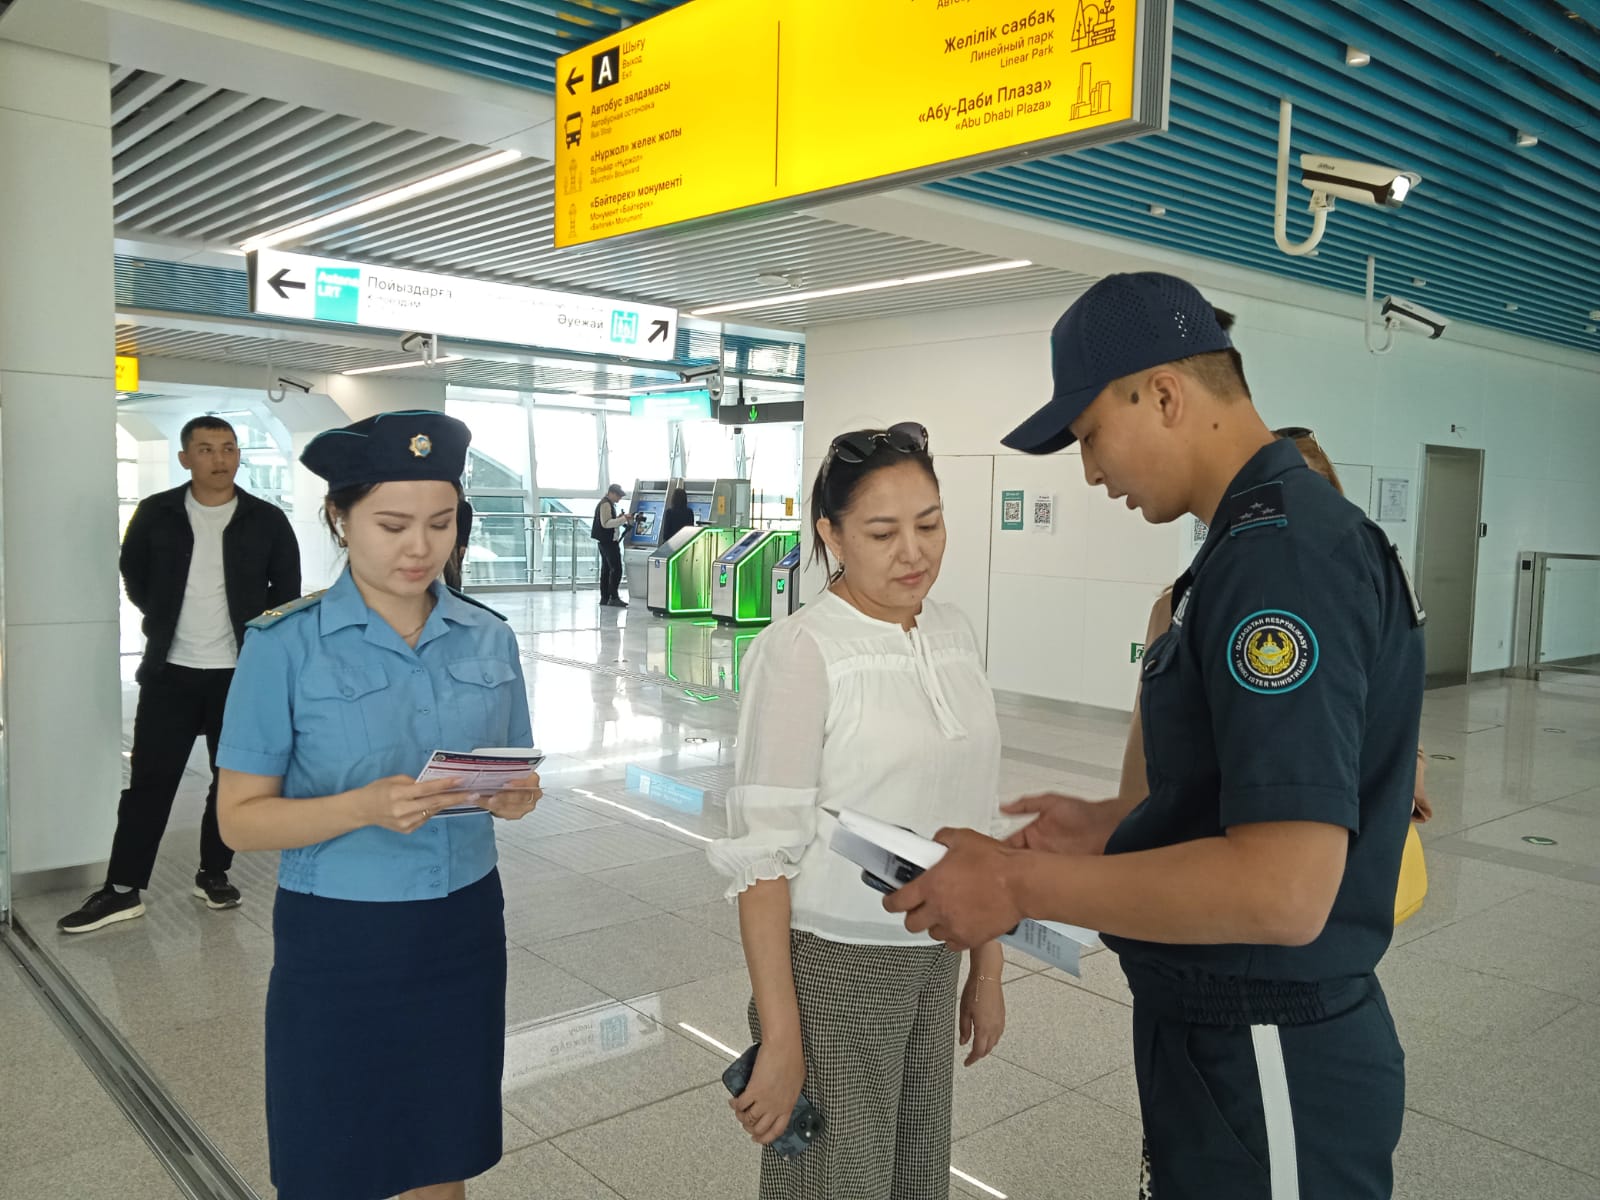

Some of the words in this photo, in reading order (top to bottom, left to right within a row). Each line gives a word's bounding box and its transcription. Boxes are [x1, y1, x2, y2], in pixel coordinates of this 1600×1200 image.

[944, 25, 997, 54] Желілік
[1001, 8, 1055, 36] саябақ
[622, 38, 646, 55] Шығу
[970, 36, 1024, 63] Линейный
[1027, 30, 1054, 47] парк
[1000, 53, 1029, 68] Linear
[1031, 45, 1054, 60] Park
[622, 55, 642, 69] Выход
[591, 98, 623, 116] Автобус
[624, 81, 671, 105] аялдамасы
[918, 93, 992, 124] «Абу-Даби
[997, 79, 1051, 103] Плаза»
[955, 114, 981, 131] «Abu
[983, 108, 1014, 124] Dhabi
[1016, 100, 1051, 116] Plaza»
[631, 136, 656, 150] желек
[658, 128, 682, 141] жолы
[637, 174, 682, 196] монументі
